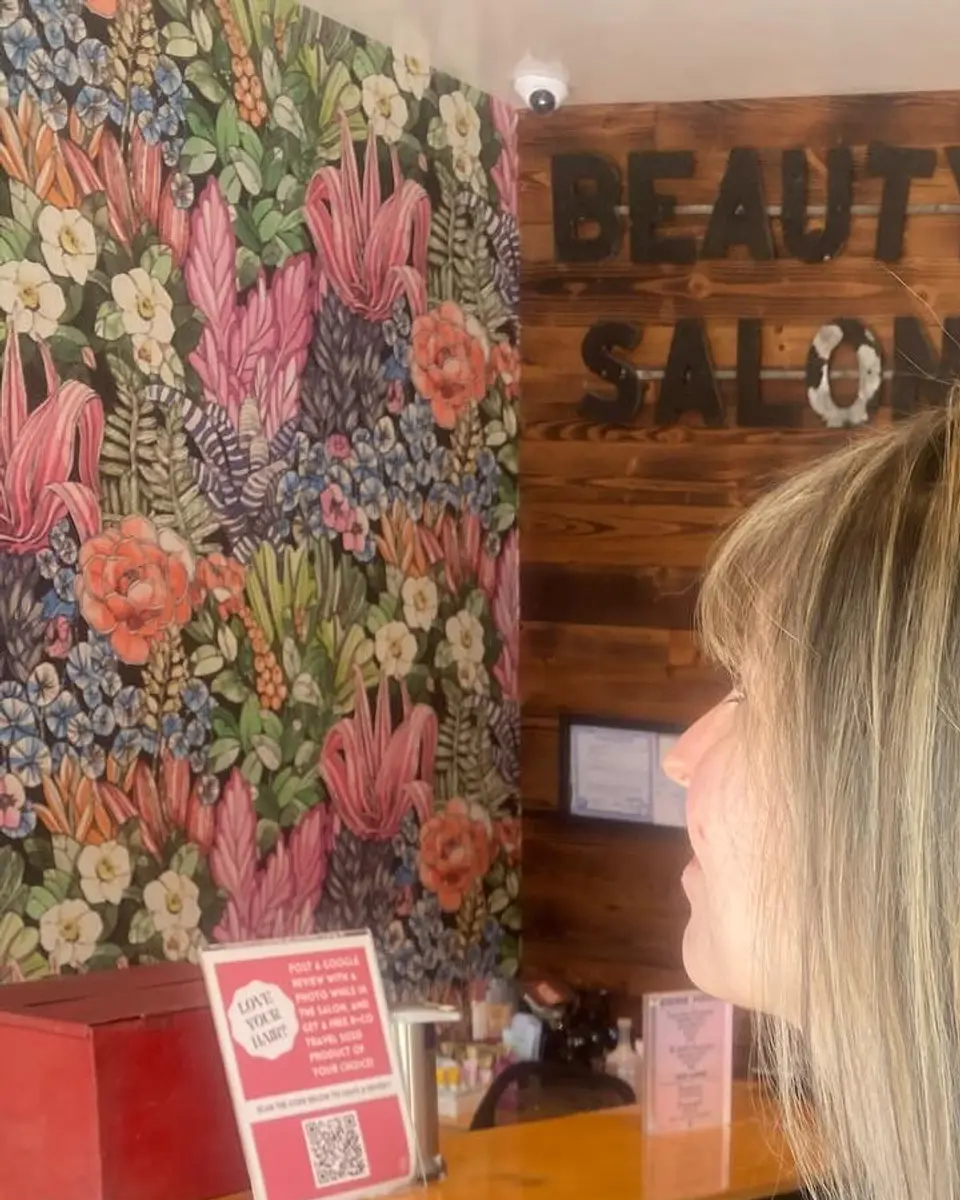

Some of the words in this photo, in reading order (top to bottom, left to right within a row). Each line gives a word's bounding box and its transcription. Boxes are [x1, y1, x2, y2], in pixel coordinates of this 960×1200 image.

[288, 960, 313, 976] POST
[314, 961, 321, 971] A
[322, 954, 360, 970] GOOGLE
[292, 976, 324, 989] REVIEW
[326, 972, 348, 984] WITH
[350, 972, 357, 981] A
[237, 990, 275, 1015] LOVE
[295, 990, 328, 1005] PHOTO
[329, 985, 356, 998] WHILE
[357, 984, 368, 995] IN
[245, 1007, 284, 1031] YOUR
[299, 1006, 315, 1020] THE
[351, 998, 370, 1012] AND
[302, 1020, 318, 1033] GET
[321, 1020, 328, 1031] A
[329, 1016, 348, 1029] FREE
[305, 1033, 338, 1048] TRAVEL
[310, 1046, 350, 1063] PRODUCT
[352, 1043, 364, 1056] OF
[312, 1063, 338, 1079] YOUR
